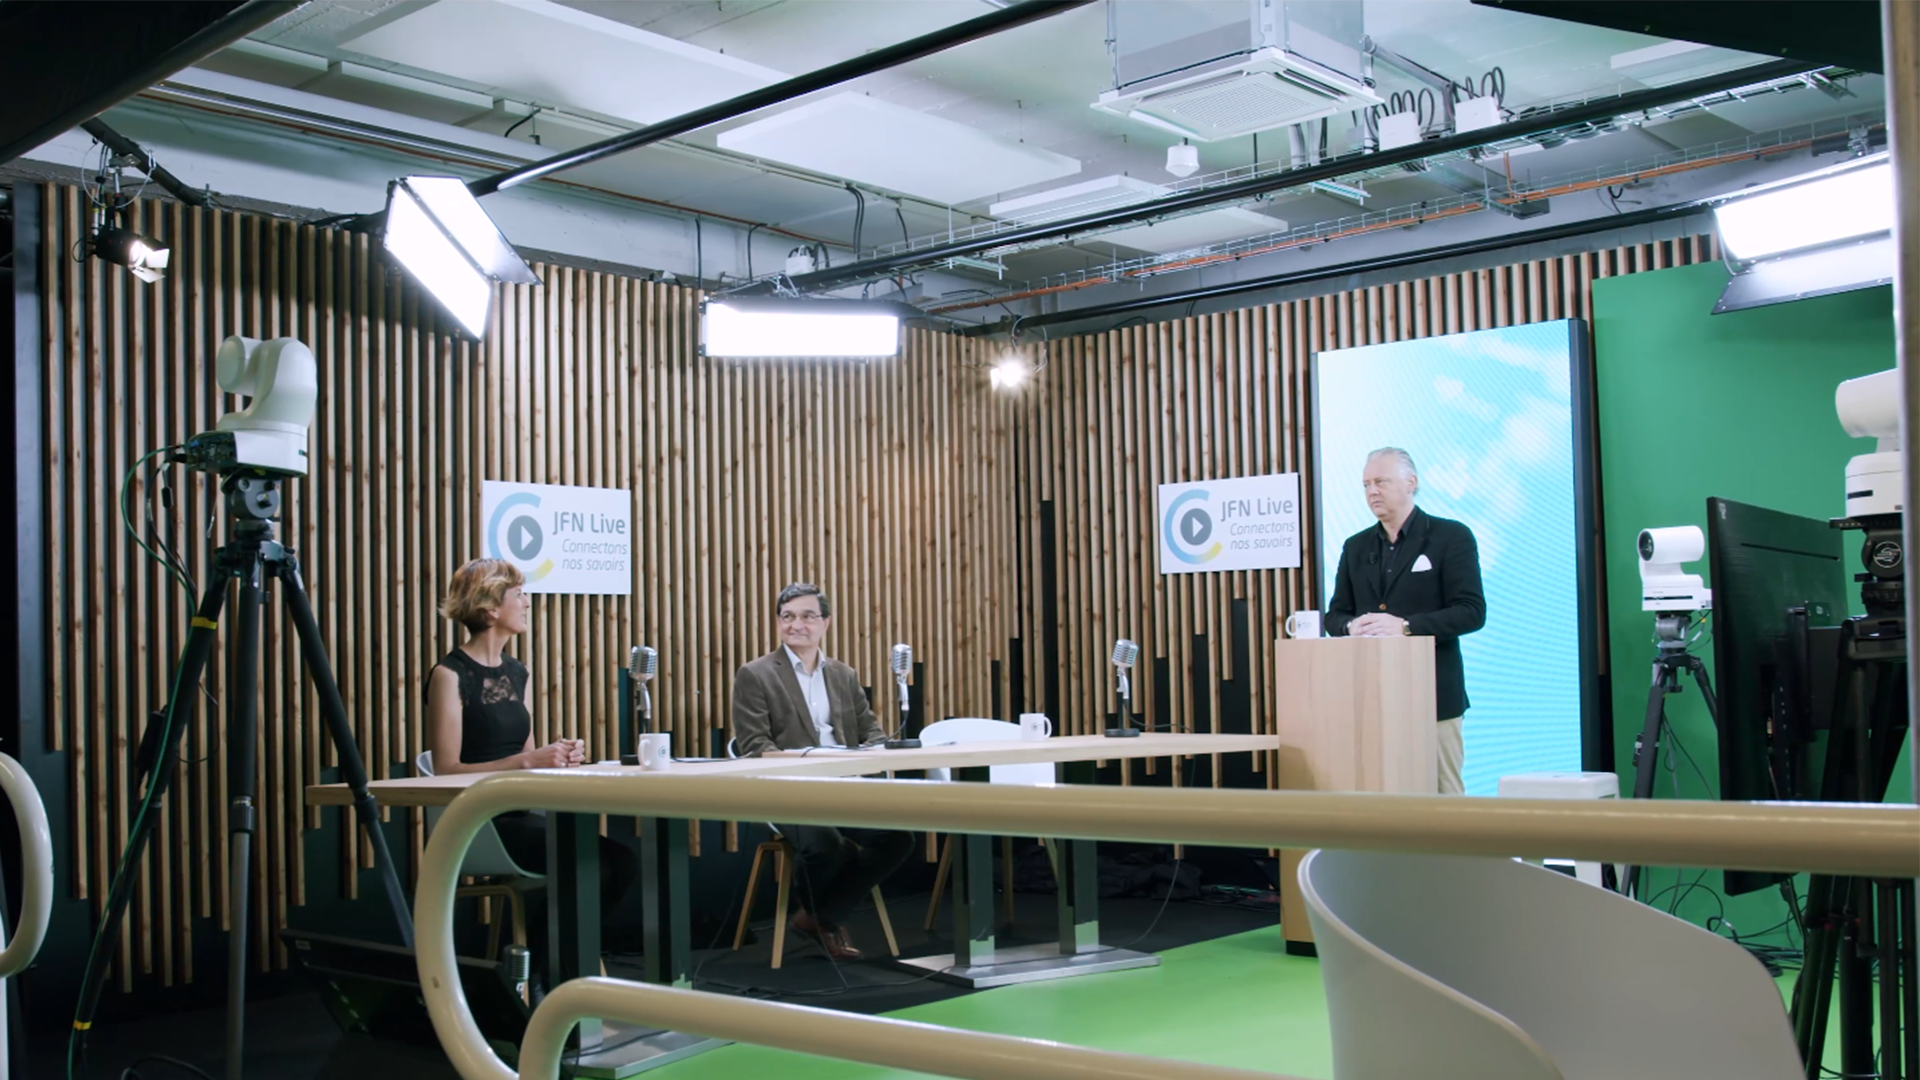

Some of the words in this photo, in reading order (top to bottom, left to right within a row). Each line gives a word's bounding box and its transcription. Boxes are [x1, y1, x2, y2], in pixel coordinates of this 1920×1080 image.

[1220, 499, 1251, 522] JFN
[1257, 497, 1293, 516] Live
[552, 511, 584, 535] JFN
[590, 513, 626, 534] Live
[1230, 521, 1295, 536] Connectons
[562, 538, 628, 555] Connectons
[1230, 539, 1250, 550] nos
[1253, 535, 1293, 549] savoirs
[562, 558, 583, 570] nos
[586, 558, 625, 572] savoirs
